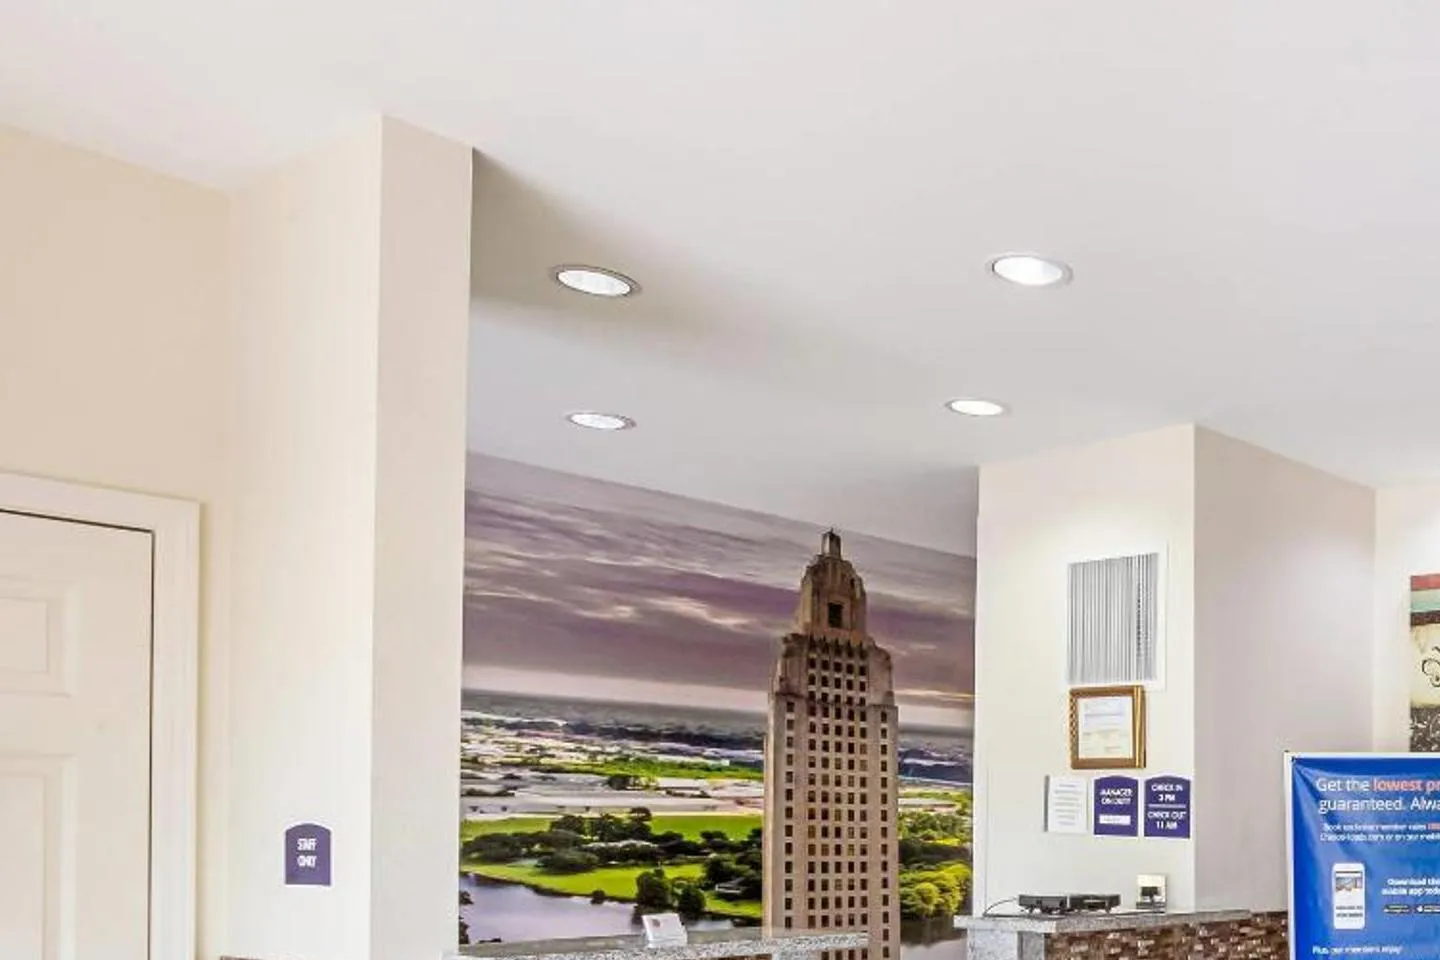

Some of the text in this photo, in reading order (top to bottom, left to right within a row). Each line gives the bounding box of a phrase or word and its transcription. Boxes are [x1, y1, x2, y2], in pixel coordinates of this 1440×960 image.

[1151, 784, 1174, 792] CHECK
[1315, 778, 1341, 792] Get
[1345, 778, 1371, 792] the
[1372, 777, 1423, 792] lowest
[1165, 794, 1175, 802] PM
[1318, 797, 1405, 815] guaranteed.
[1147, 811, 1187, 820] CHECK OUT
[1157, 821, 1178, 830] 11 AM
